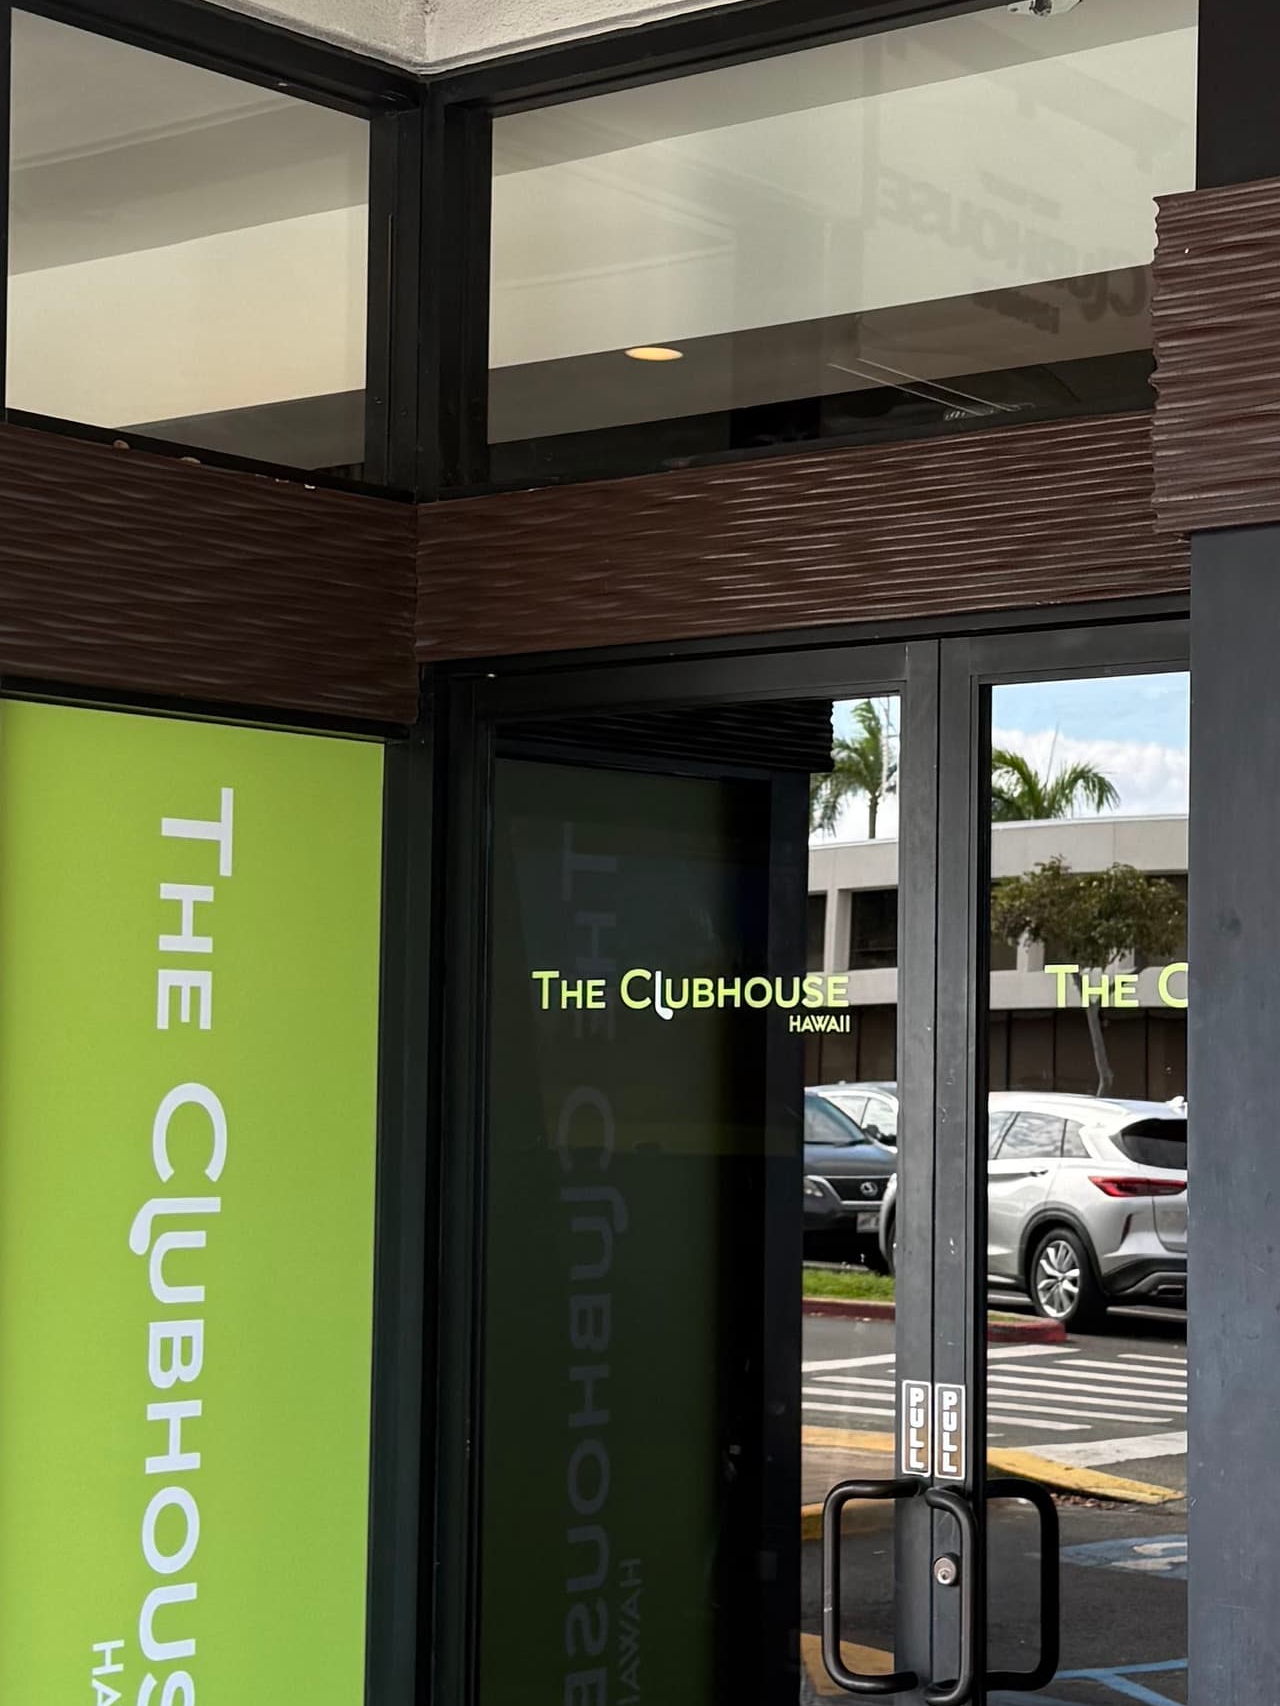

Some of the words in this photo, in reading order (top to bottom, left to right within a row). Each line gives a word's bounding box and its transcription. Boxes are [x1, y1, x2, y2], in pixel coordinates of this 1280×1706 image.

[156, 787, 234, 1030] THE
[531, 970, 606, 1009] THE
[620, 968, 849, 1021] CLUBHOUSE
[1044, 964, 1139, 1008] THE
[790, 1014, 850, 1032] HAWAII
[909, 1387, 925, 1469] PULL
[942, 1391, 958, 1473] PULL
